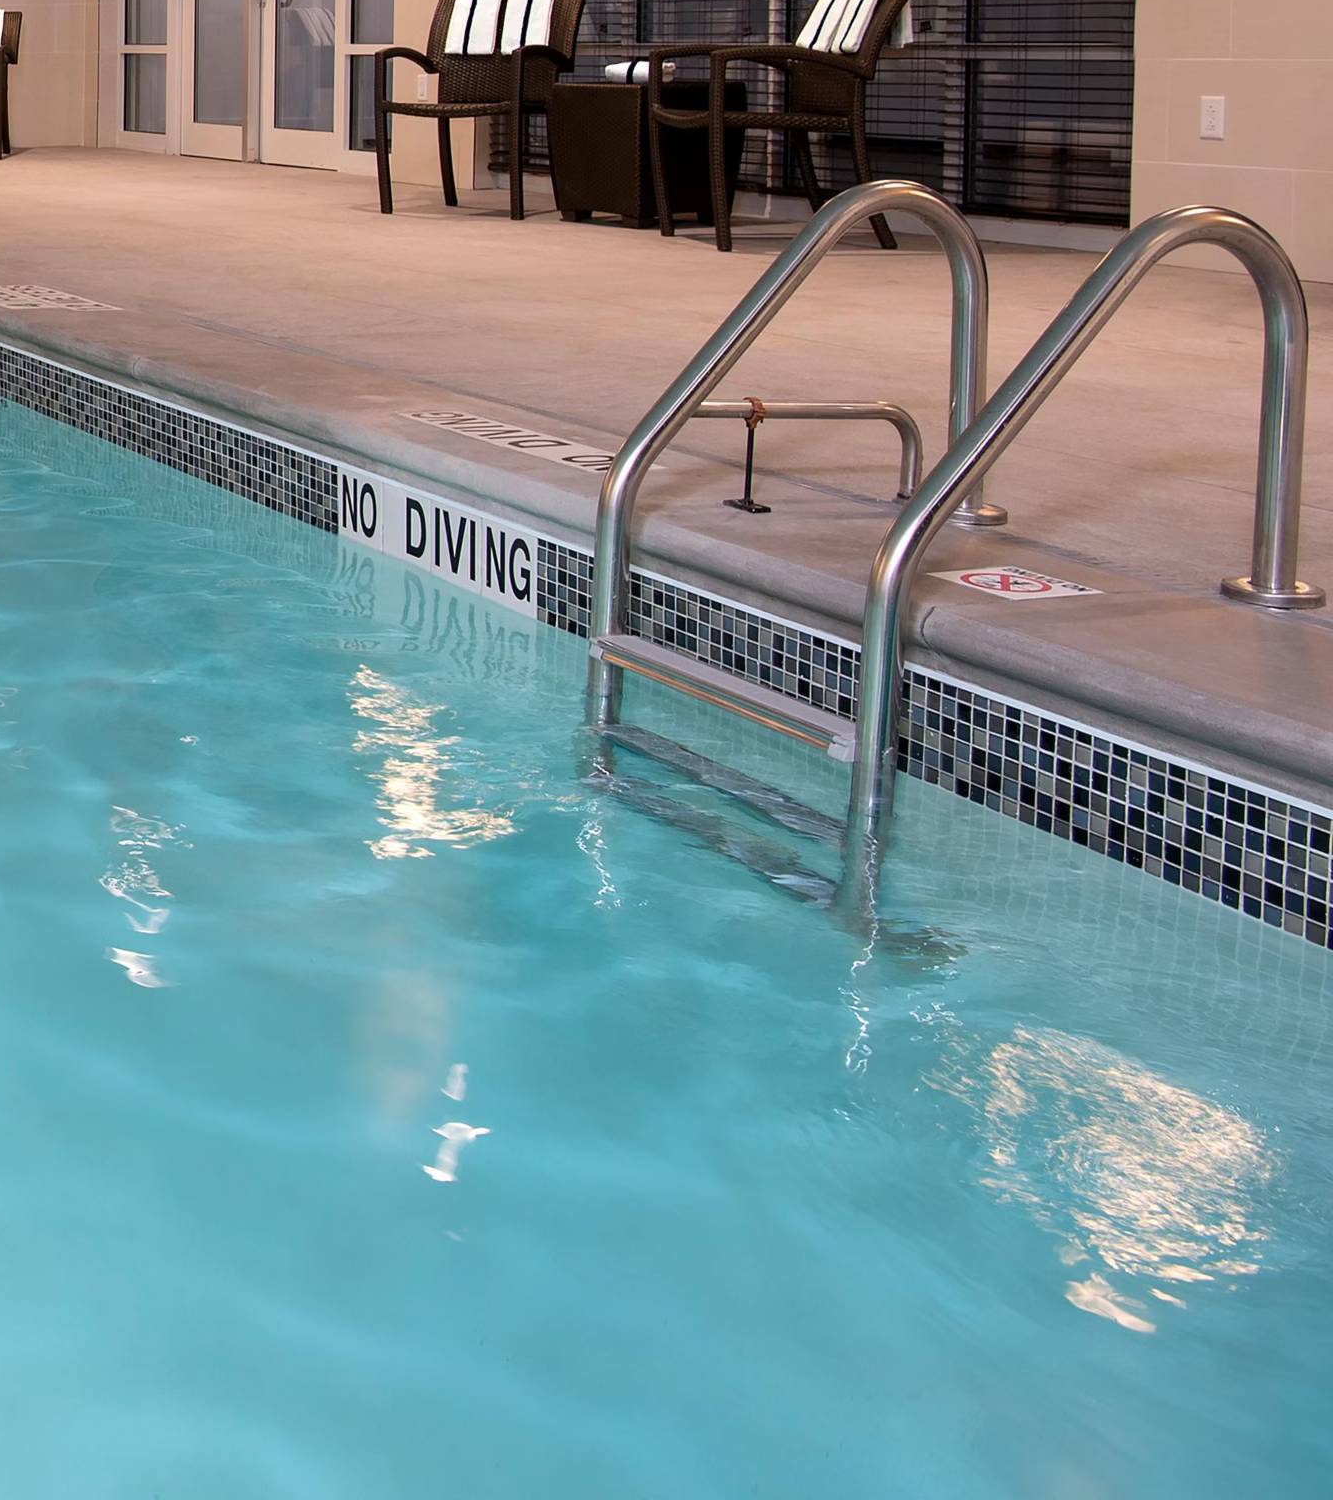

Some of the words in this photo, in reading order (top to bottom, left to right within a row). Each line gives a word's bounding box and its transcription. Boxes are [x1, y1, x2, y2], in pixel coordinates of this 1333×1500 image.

[412, 412, 572, 449] DIVING
[342, 474, 377, 538] NO
[406, 497, 531, 603] DIVING
